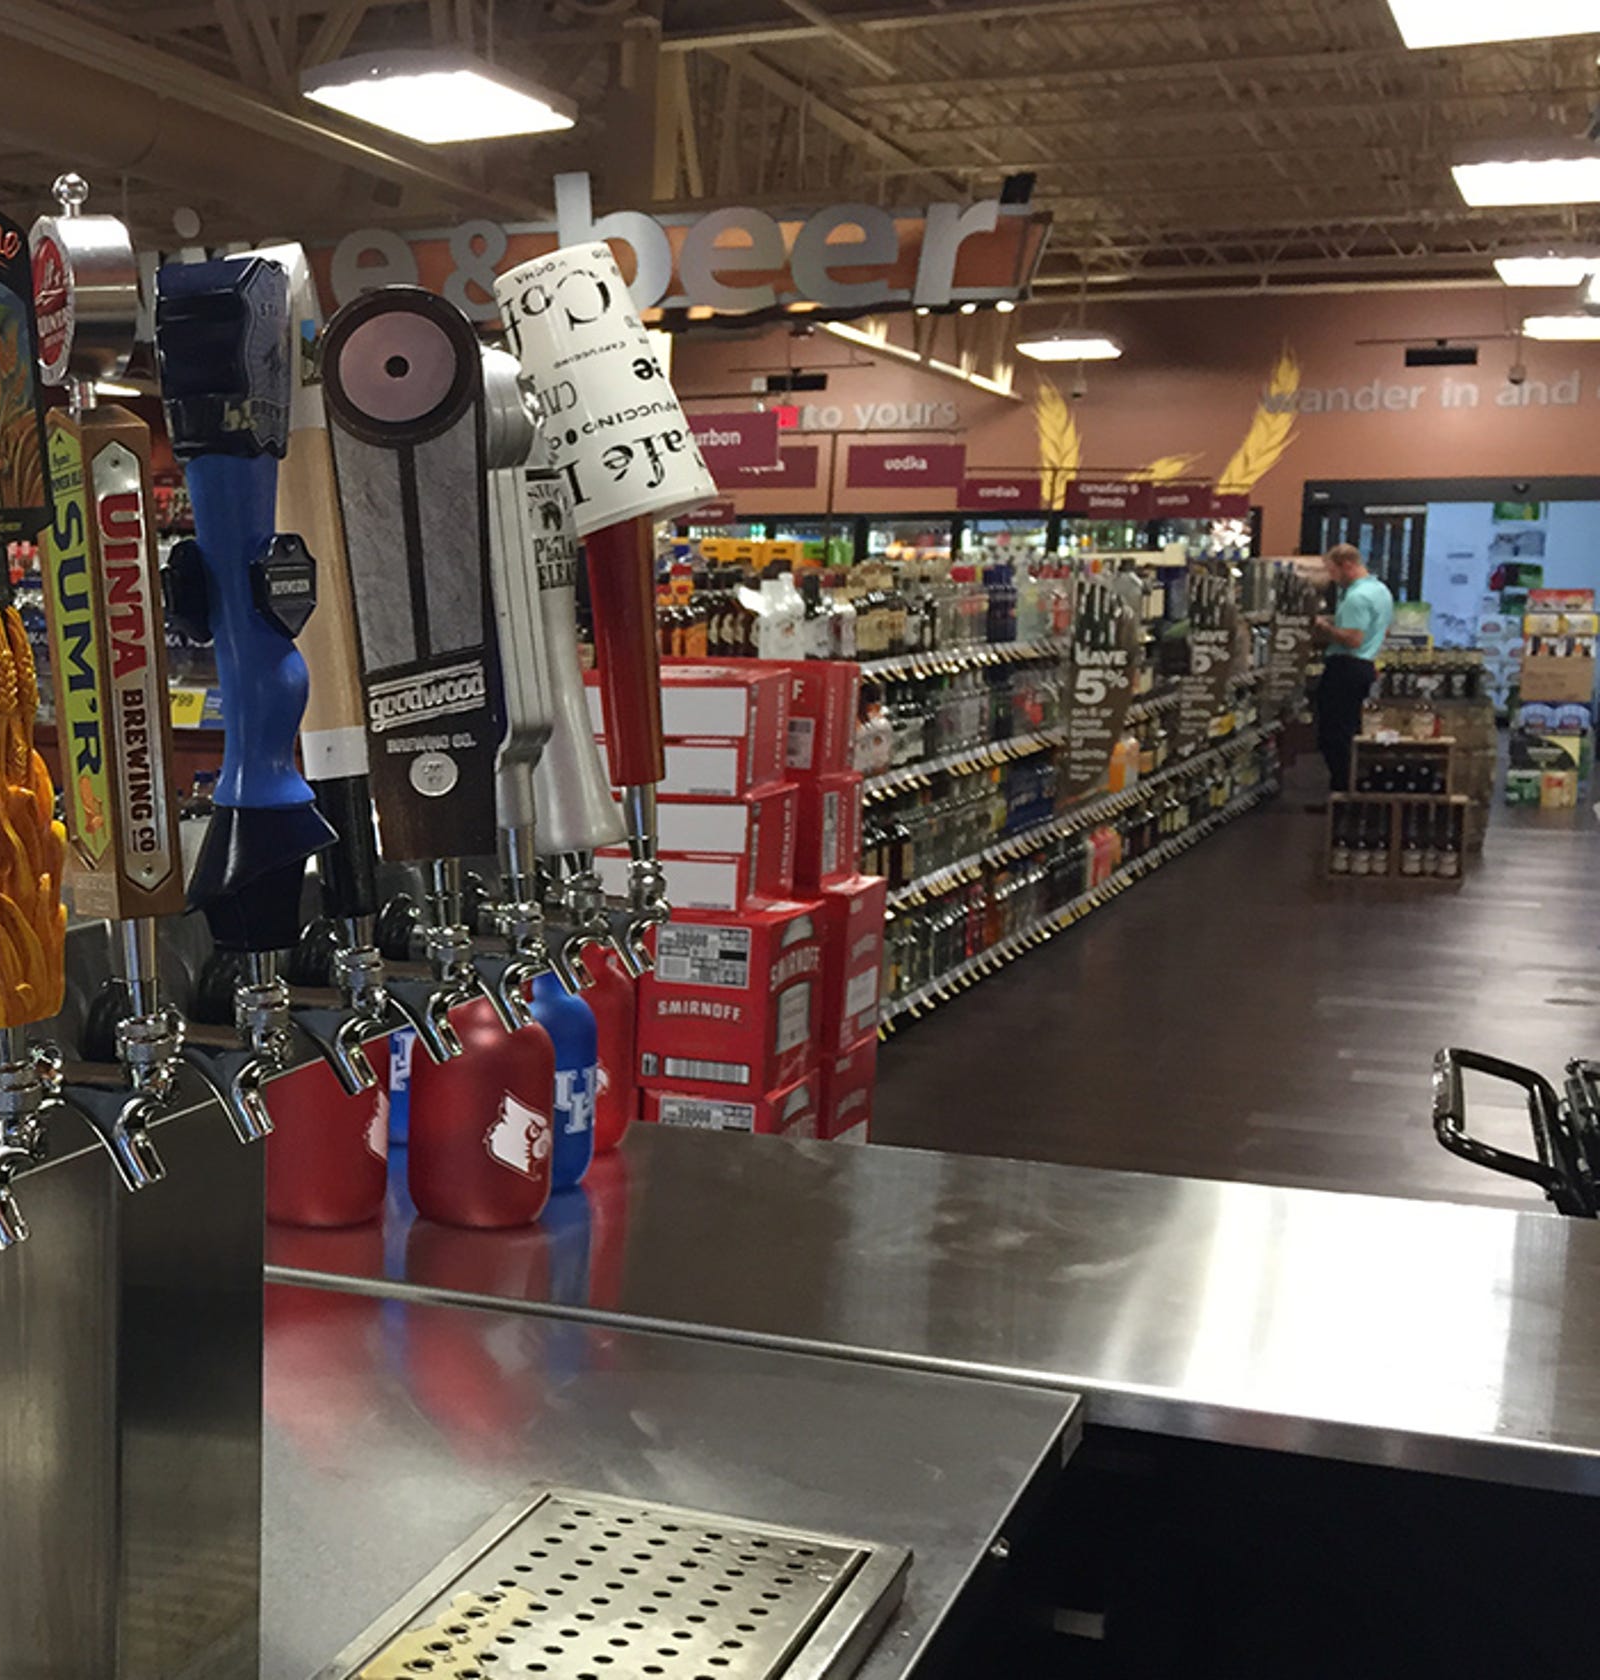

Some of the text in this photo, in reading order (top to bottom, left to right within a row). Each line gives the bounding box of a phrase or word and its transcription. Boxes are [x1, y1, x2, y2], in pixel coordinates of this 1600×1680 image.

[555, 172, 1000, 314] beer
[1259, 370, 1580, 414] wander in and
[696, 419, 741, 447] urbon
[802, 401, 960, 430] to yours
[602, 428, 688, 489] afé
[883, 456, 927, 471] vodka
[97, 491, 155, 853] UINTA BREWING CO
[1074, 669, 1129, 704] 5%
[369, 668, 486, 733] goodwood
[658, 1000, 742, 1021] SMIRNOFF
